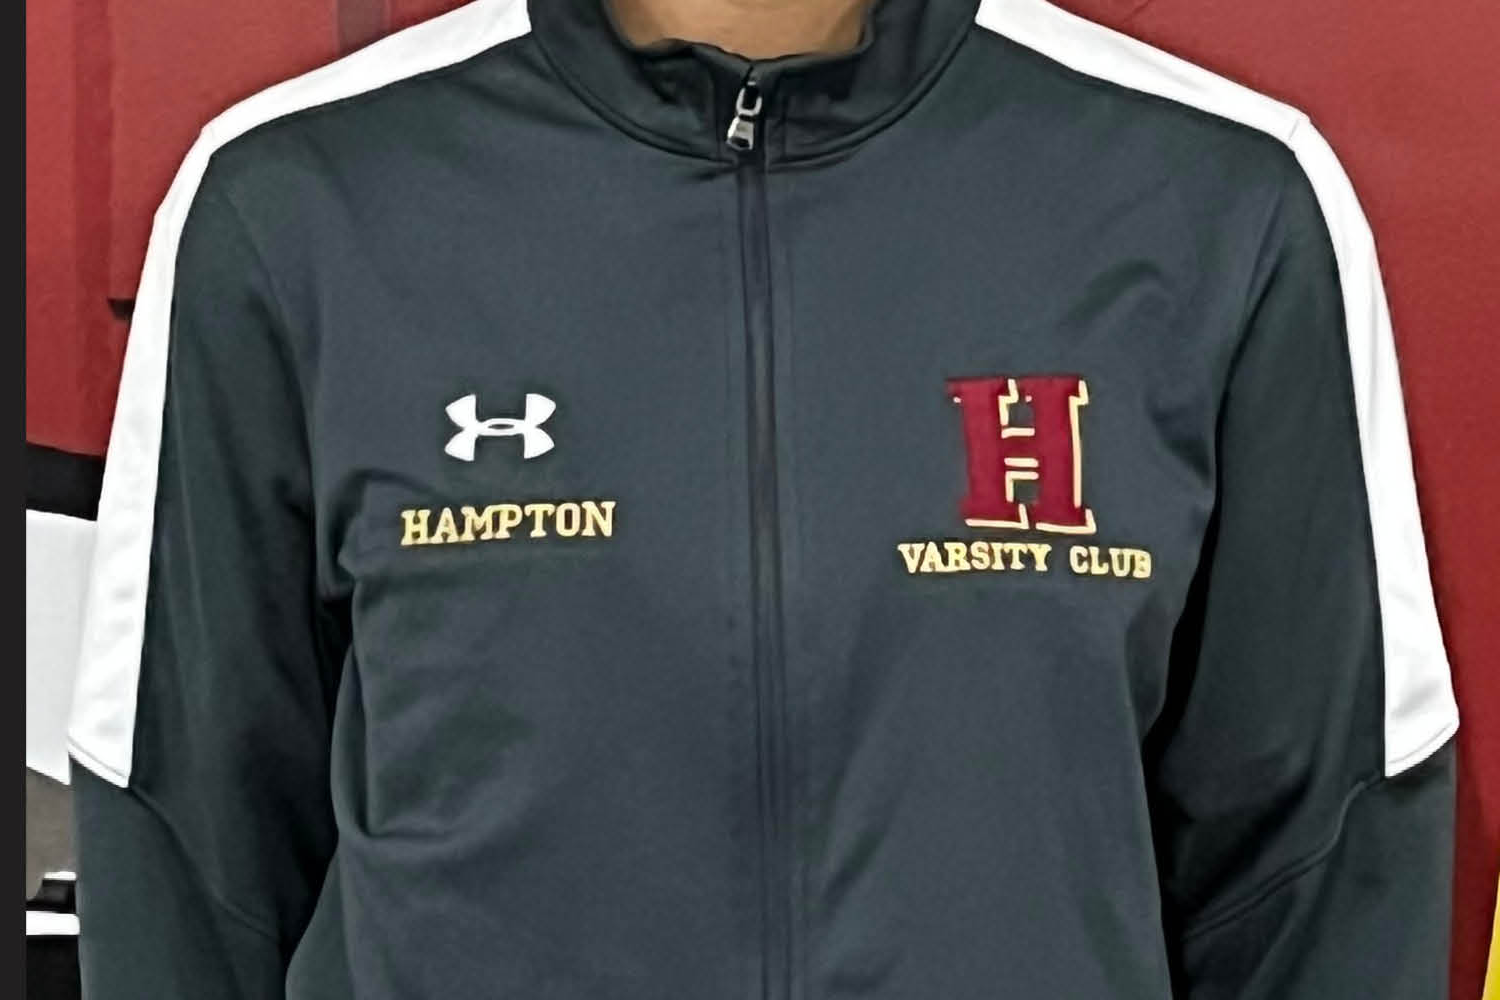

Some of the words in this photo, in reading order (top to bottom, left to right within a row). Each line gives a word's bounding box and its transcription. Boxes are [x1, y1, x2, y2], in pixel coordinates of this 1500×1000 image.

[946, 375, 1097, 535] H
[400, 501, 616, 546] HAMPTON
[897, 541, 1052, 574] VARSITY
[1069, 545, 1152, 579] CLUB
